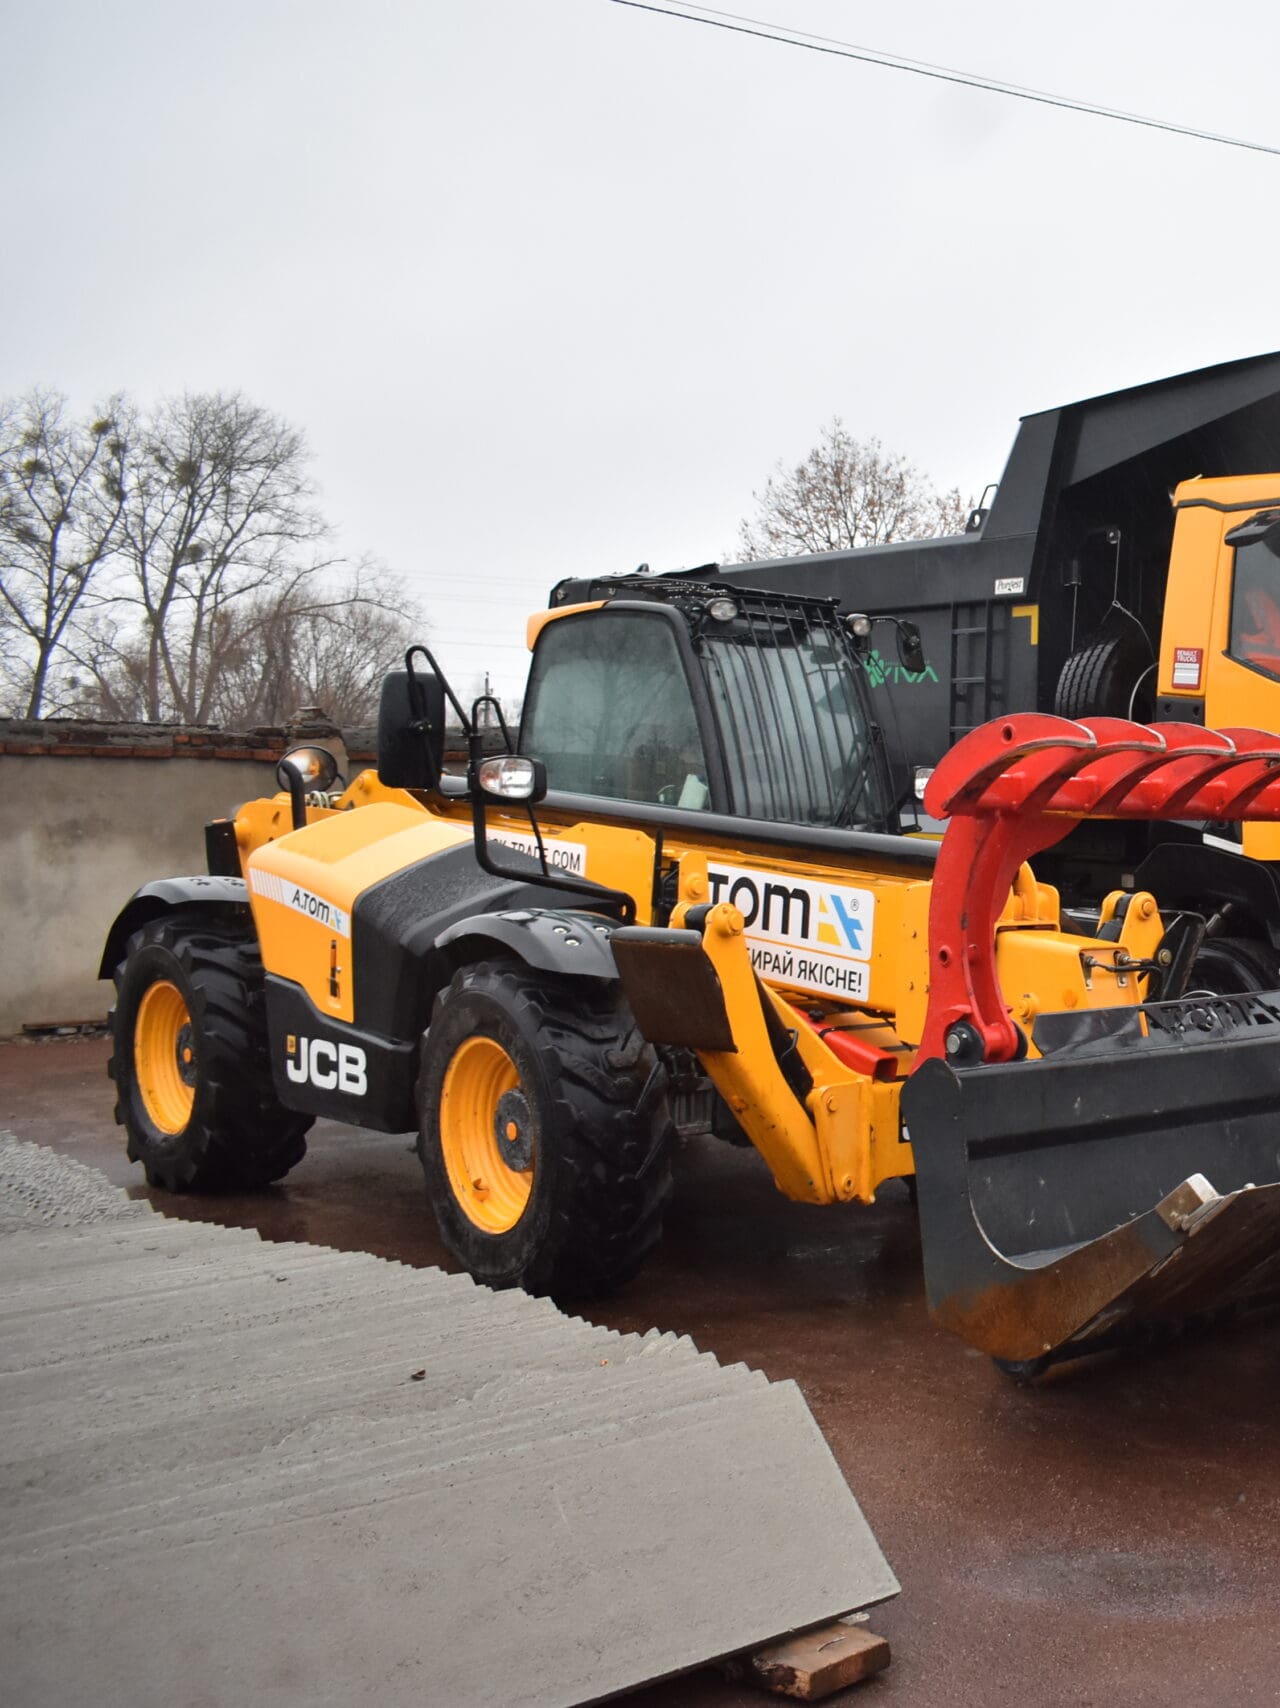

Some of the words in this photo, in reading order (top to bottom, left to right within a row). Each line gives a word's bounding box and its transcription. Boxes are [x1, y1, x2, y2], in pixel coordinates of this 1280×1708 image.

[747, 947, 794, 977] ИРАЙ
[797, 960, 863, 993] ЯКІСНЕ!
[286, 1036, 368, 1096] JCB
